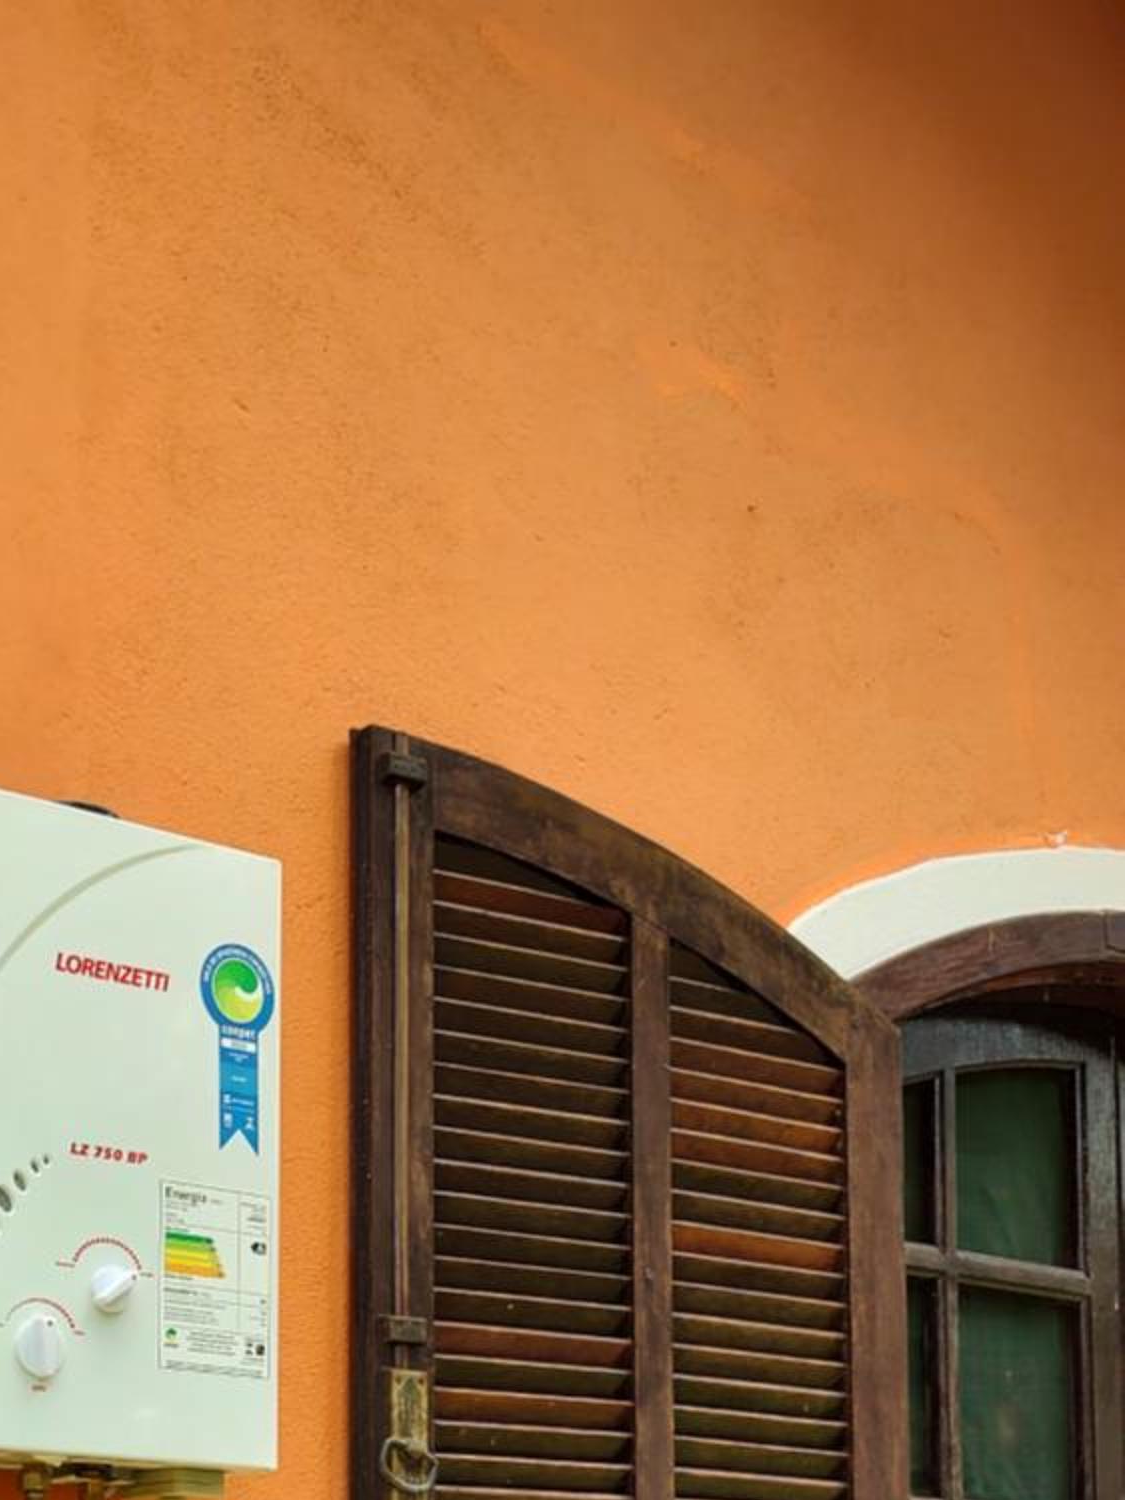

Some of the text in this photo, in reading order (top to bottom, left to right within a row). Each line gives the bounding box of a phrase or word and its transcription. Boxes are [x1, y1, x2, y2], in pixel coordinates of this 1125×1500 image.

[56, 952, 170, 992] LORENZETTI
[70, 1142, 148, 1165] LZ 750 BP
[165, 1186, 207, 1207] Energia
